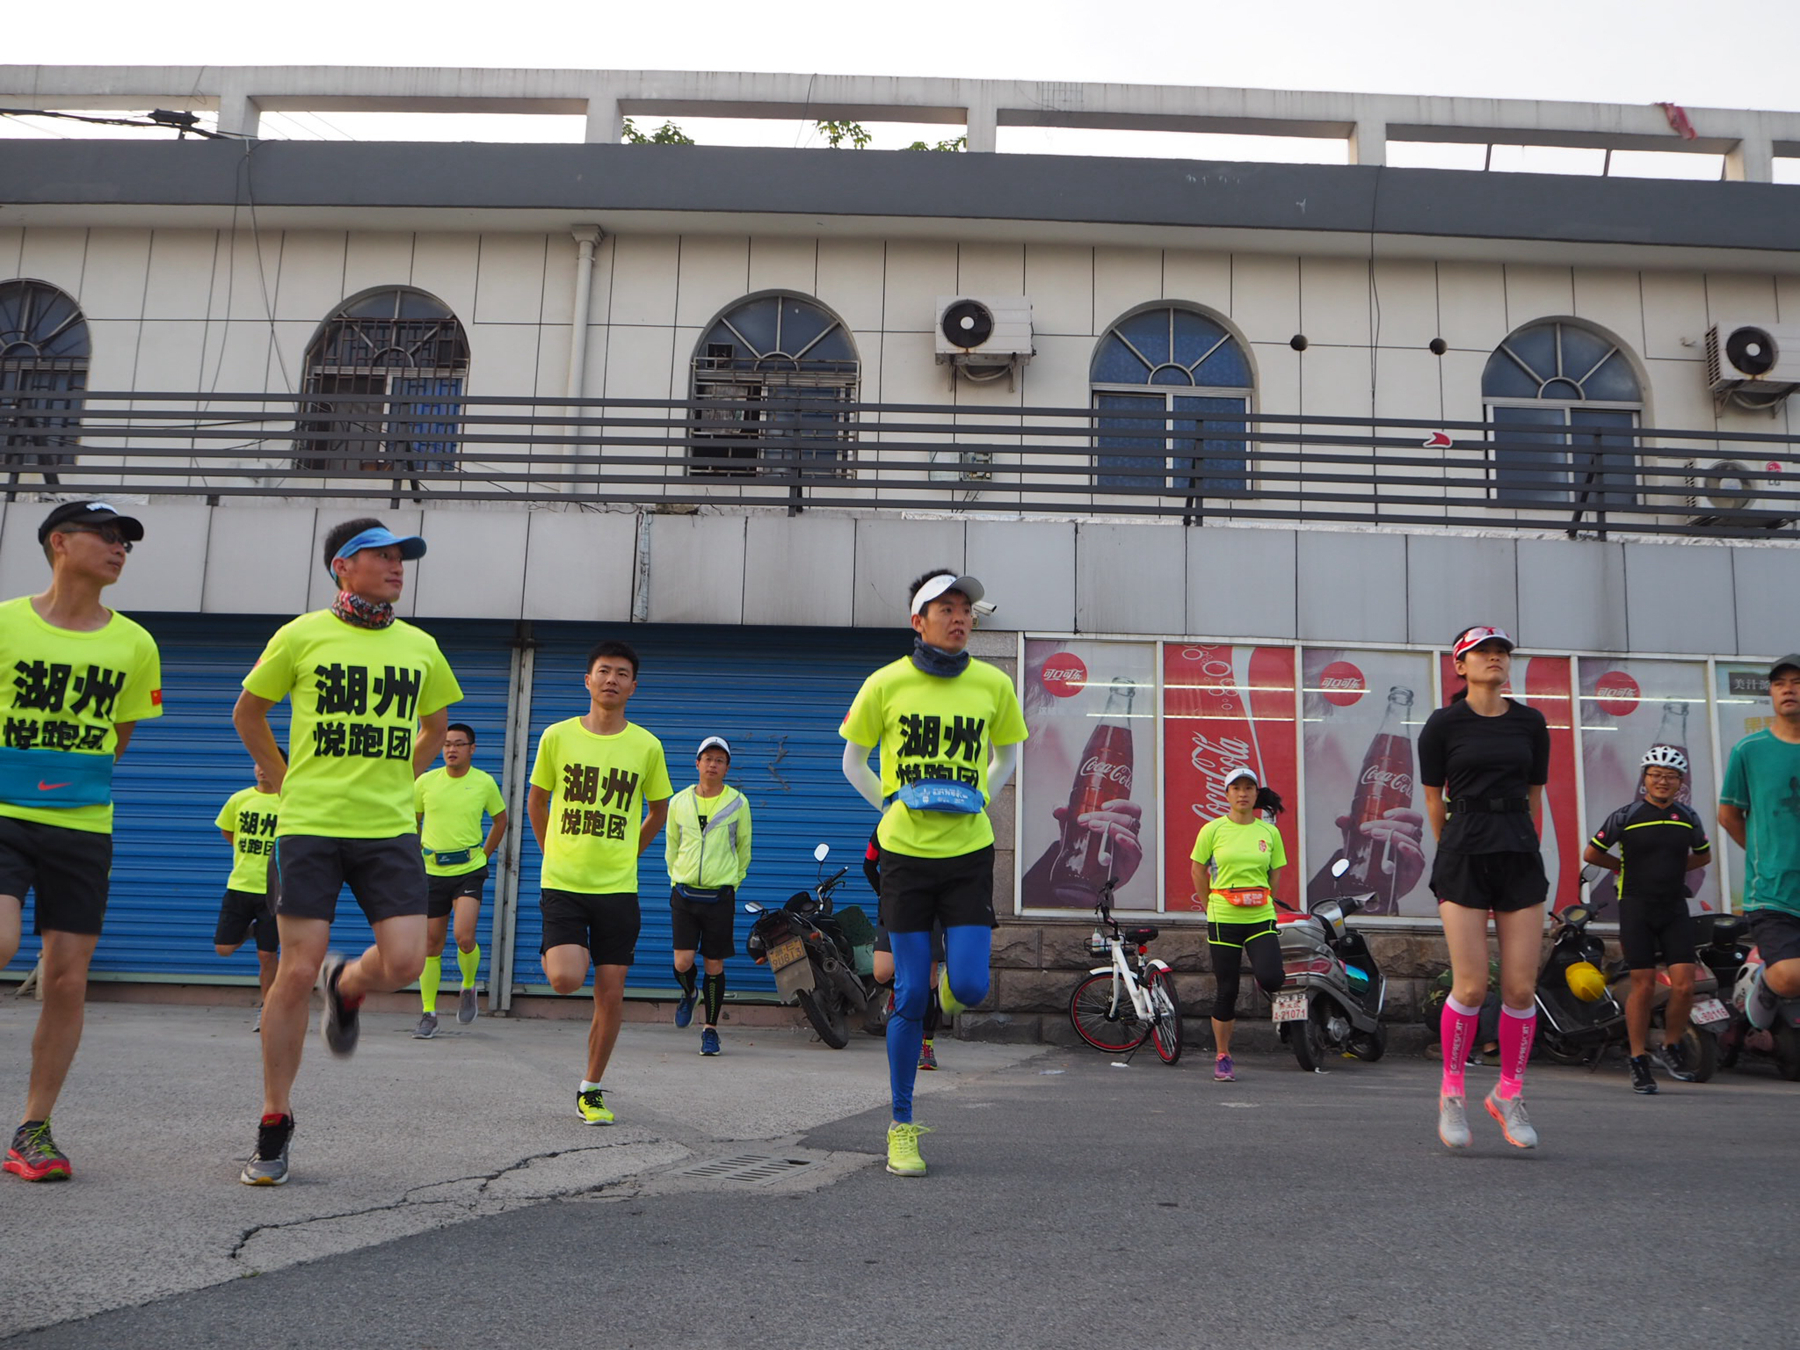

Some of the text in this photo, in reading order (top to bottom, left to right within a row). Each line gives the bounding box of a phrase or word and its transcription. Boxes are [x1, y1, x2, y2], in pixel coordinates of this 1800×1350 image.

[11, 660, 127, 722] 湖州
[314, 663, 421, 721] 湖州
[1043, 668, 1084, 681] 可口可乐
[1321, 677, 1362, 689] 可口可乐
[3, 717, 109, 751] 悦跑团
[313, 721, 411, 761] 悦跑团
[897, 714, 985, 763] 湖州
[563, 763, 640, 812] 湖州
[239, 811, 278, 837] 湖州
[561, 808, 628, 841] 悦跑团
